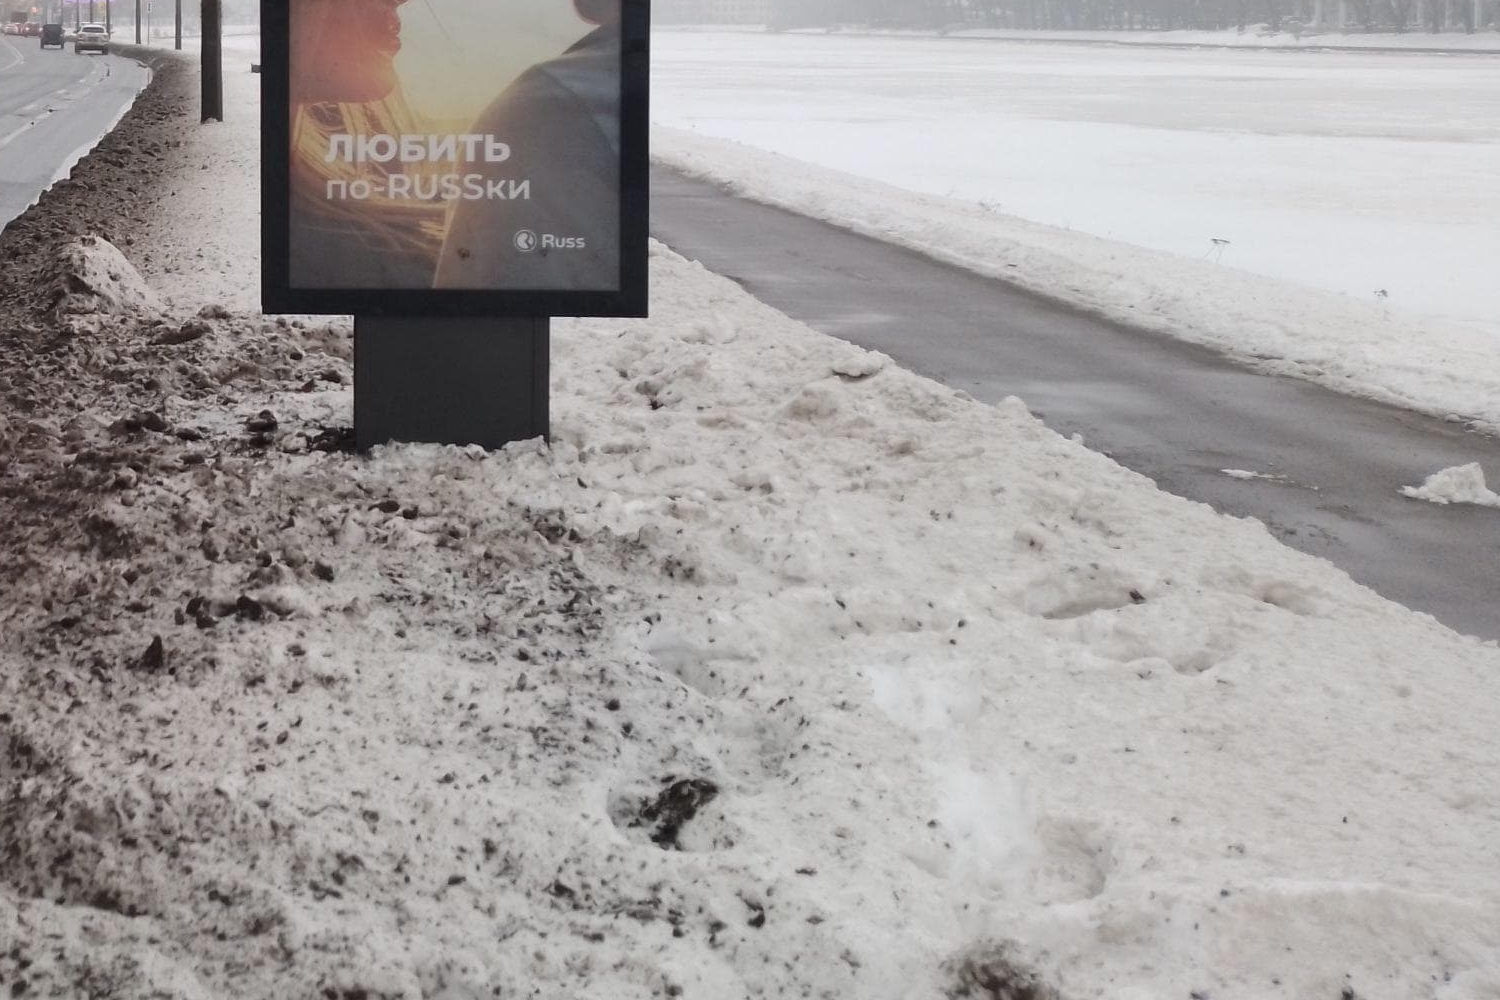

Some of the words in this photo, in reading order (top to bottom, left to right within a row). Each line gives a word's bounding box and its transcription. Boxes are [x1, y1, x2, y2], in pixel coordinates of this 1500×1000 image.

[324, 133, 511, 163] ЛЮБИТЬ
[326, 173, 531, 201] по-RUSSки
[541, 233, 586, 248] Russ
